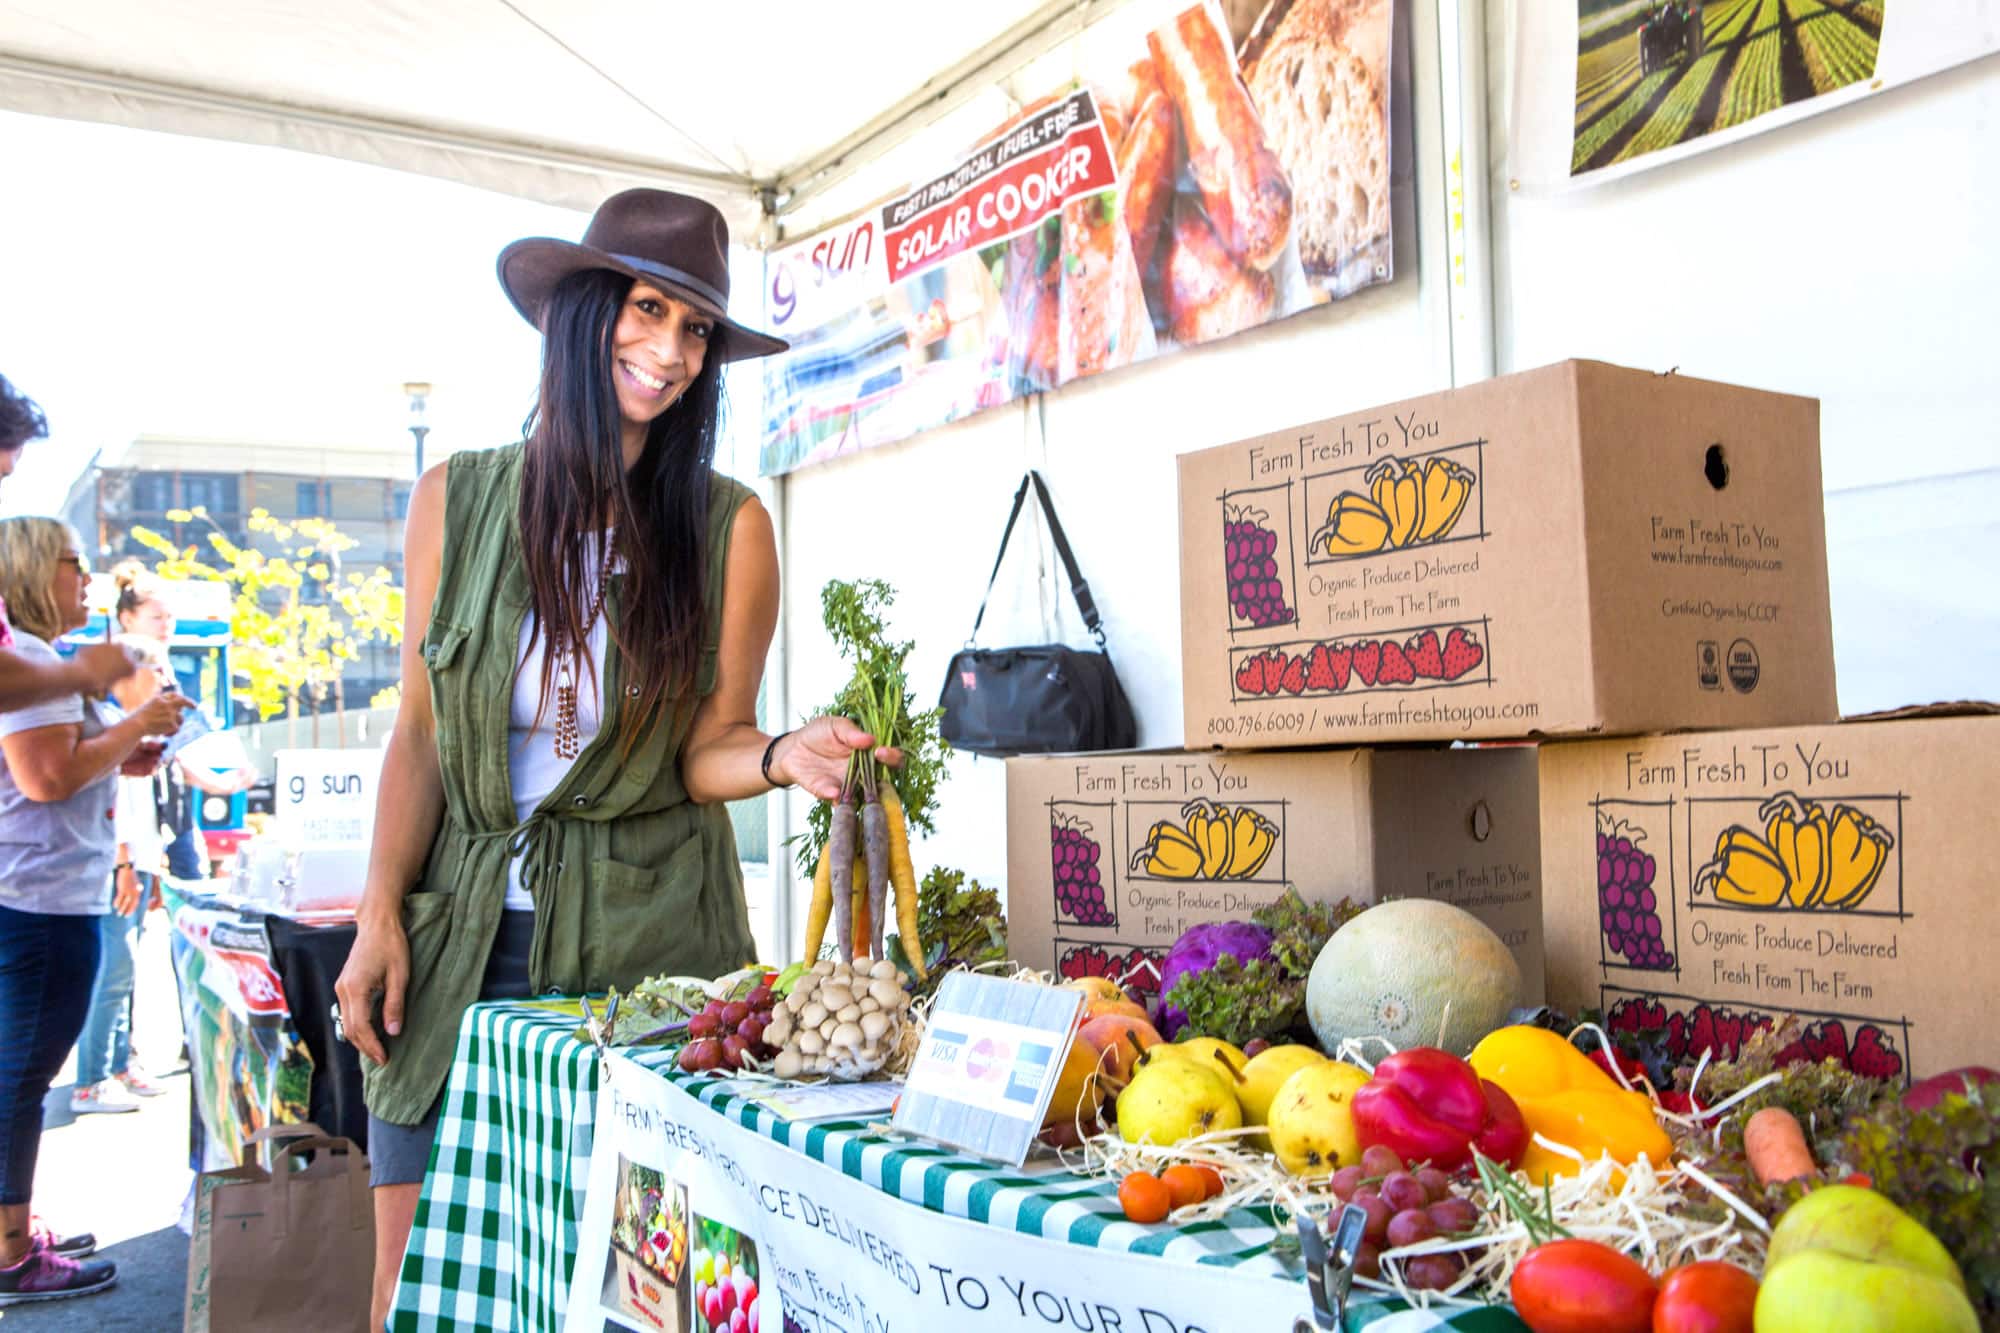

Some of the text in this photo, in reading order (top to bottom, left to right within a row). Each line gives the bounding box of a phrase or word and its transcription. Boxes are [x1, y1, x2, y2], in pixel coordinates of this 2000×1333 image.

[893, 197, 919, 223] FAST
[929, 155, 994, 201] PRACTICAL
[895, 145, 1091, 271] SOLAR COOKER
[1249, 410, 1440, 480] Farm Fresh To You
[1651, 515, 1779, 550] Farm Fresh To You
[1308, 551, 1479, 598] Organic Produce Delivered
[1651, 546, 1783, 576] www.farmfreshtoyou.com
[1327, 591, 1460, 625] Fresh From The Farm
[1207, 711, 1304, 736] 800.796.6009
[1323, 697, 1539, 731] www.farmfreshtoyou.com
[322, 774, 362, 794] sun
[1076, 763, 1248, 794] Farm Fresh To You
[1627, 742, 1849, 791] Farm Fresh To You
[1457, 865, 1489, 889] Fresh
[1508, 864, 1530, 886] You
[1128, 889, 1172, 912] Organic
[1177, 890, 1220, 911] Produce
[1145, 917, 1174, 936] Fresh
[1691, 920, 1897, 960] Organic Produce Delivered
[1713, 959, 1873, 999] Fresh From The Farm
[931, 1041, 958, 1064] VISA
[614, 1088, 652, 1132] FRM
[799, 1193, 920, 1295] DELIVERED
[928, 1263, 988, 1310] TO
[805, 1268, 855, 1320] Fresh
